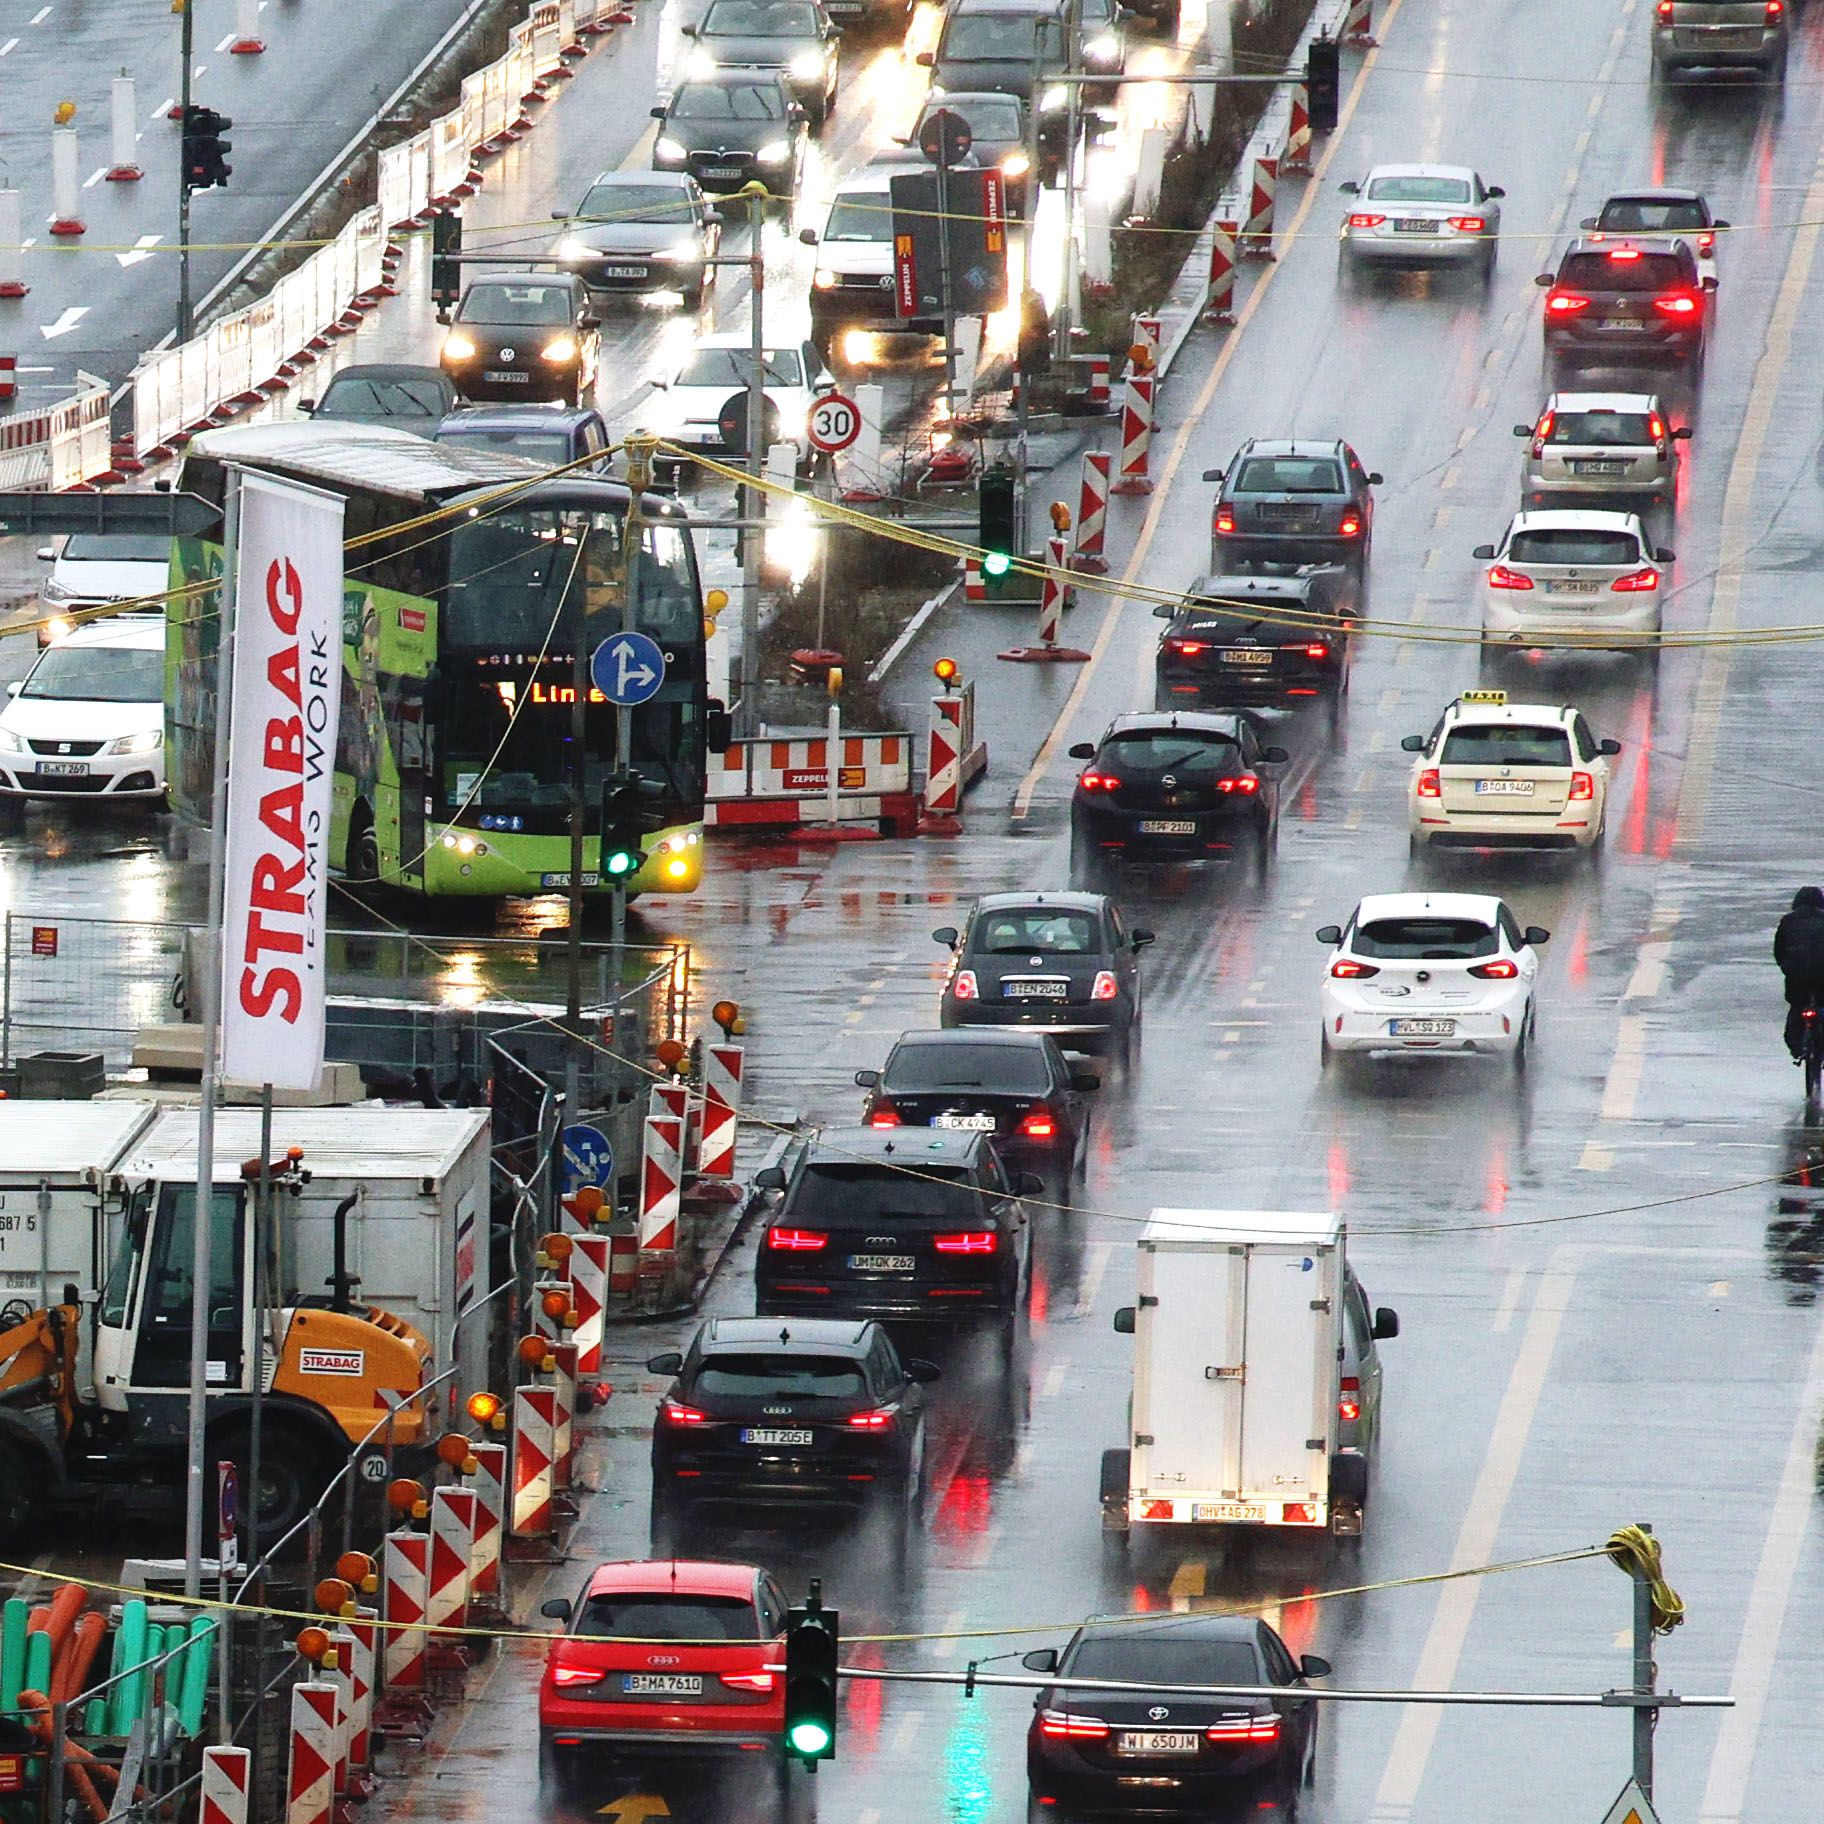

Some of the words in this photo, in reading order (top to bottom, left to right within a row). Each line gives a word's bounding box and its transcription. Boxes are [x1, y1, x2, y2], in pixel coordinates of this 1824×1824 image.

[901, 262, 912, 308] ZEPPELIN
[816, 410, 850, 436] 30
[791, 773, 828, 783] ZEPPELI
[238, 555, 306, 1025] STRABAG
[1009, 984, 1019, 996] B
[1039, 984, 1066, 996] 2046
[1434, 1021, 1453, 1034] 123
[935, 1116, 944, 1128] B
[950, 1116, 965, 1128] CK
[965, 1116, 995, 1128] 4745
[26, 1215, 36, 1232] 5
[892, 1256, 914, 1269] 262
[302, 1355, 362, 1369] STRABAG
[746, 1430, 755, 1444] B
[762, 1430, 779, 1444] TT
[1245, 1506, 1265, 1519] 278
[631, 1677, 639, 1691] B
[648, 1677, 665, 1691] MA
[667, 1677, 701, 1691] 7610
[1127, 1734, 1144, 1749] WI
